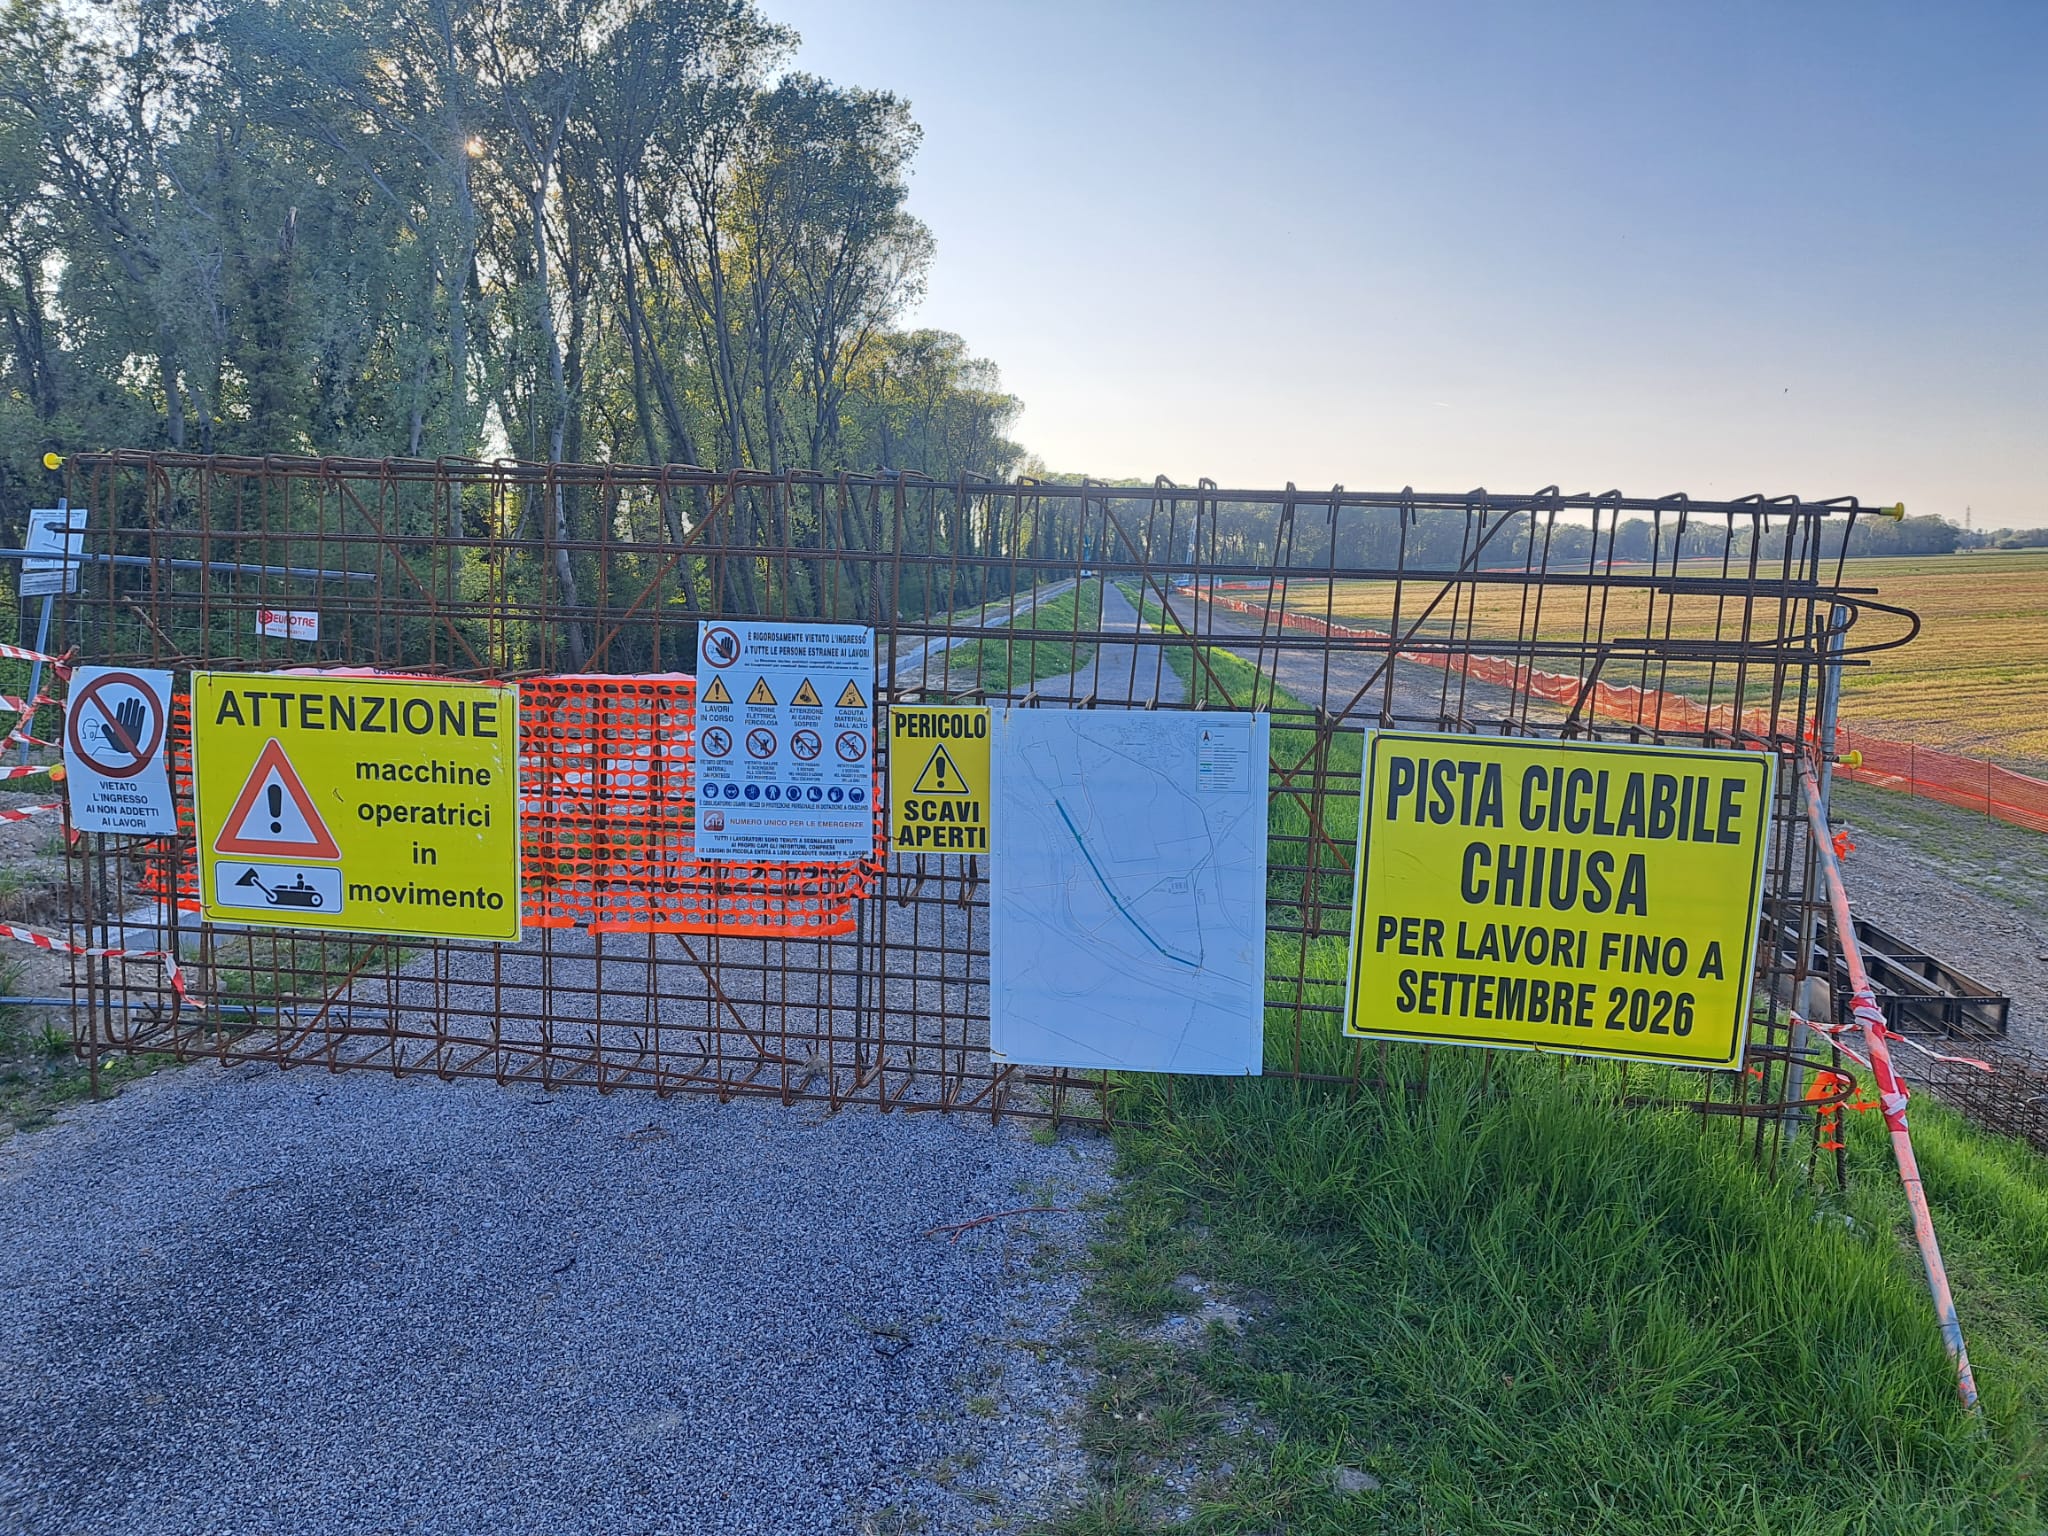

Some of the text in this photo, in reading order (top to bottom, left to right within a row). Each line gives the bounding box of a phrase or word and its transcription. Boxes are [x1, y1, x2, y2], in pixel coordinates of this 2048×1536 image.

[754, 632, 803, 642] RIGOROSAMENTE
[806, 633, 829, 643] VIETATO
[831, 634, 866, 644] L'INGRESSO
[745, 646, 748, 654] A
[750, 646, 768, 655] TUTTE
[771, 647, 777, 655] LE
[780, 647, 806, 656] PERSONE
[808, 648, 838, 657] ESTRANEE
[848, 649, 869, 657] LAVORI
[216, 690, 498, 738] ATTENZIONE
[896, 714, 986, 738] PERICOLO
[356, 760, 491, 786] macchine
[93, 793, 148, 804] L'INGRESSO
[100, 782, 137, 791] VIETATO
[86, 805, 159, 816] AI NON ADDETTI
[904, 800, 979, 822] SCAVI
[1386, 756, 1745, 844] PISTA CICLABILE
[113, 819, 146, 827] LAVORI
[358, 802, 490, 828] operatrici
[899, 825, 986, 848] APERTI
[412, 841, 436, 865] in
[1460, 841, 1648, 916] CHIUSA
[349, 882, 504, 910] movimento
[1376, 916, 1724, 980] PER LAVORI FINO A
[1396, 969, 1695, 1037] SETTEMBRE 2026
